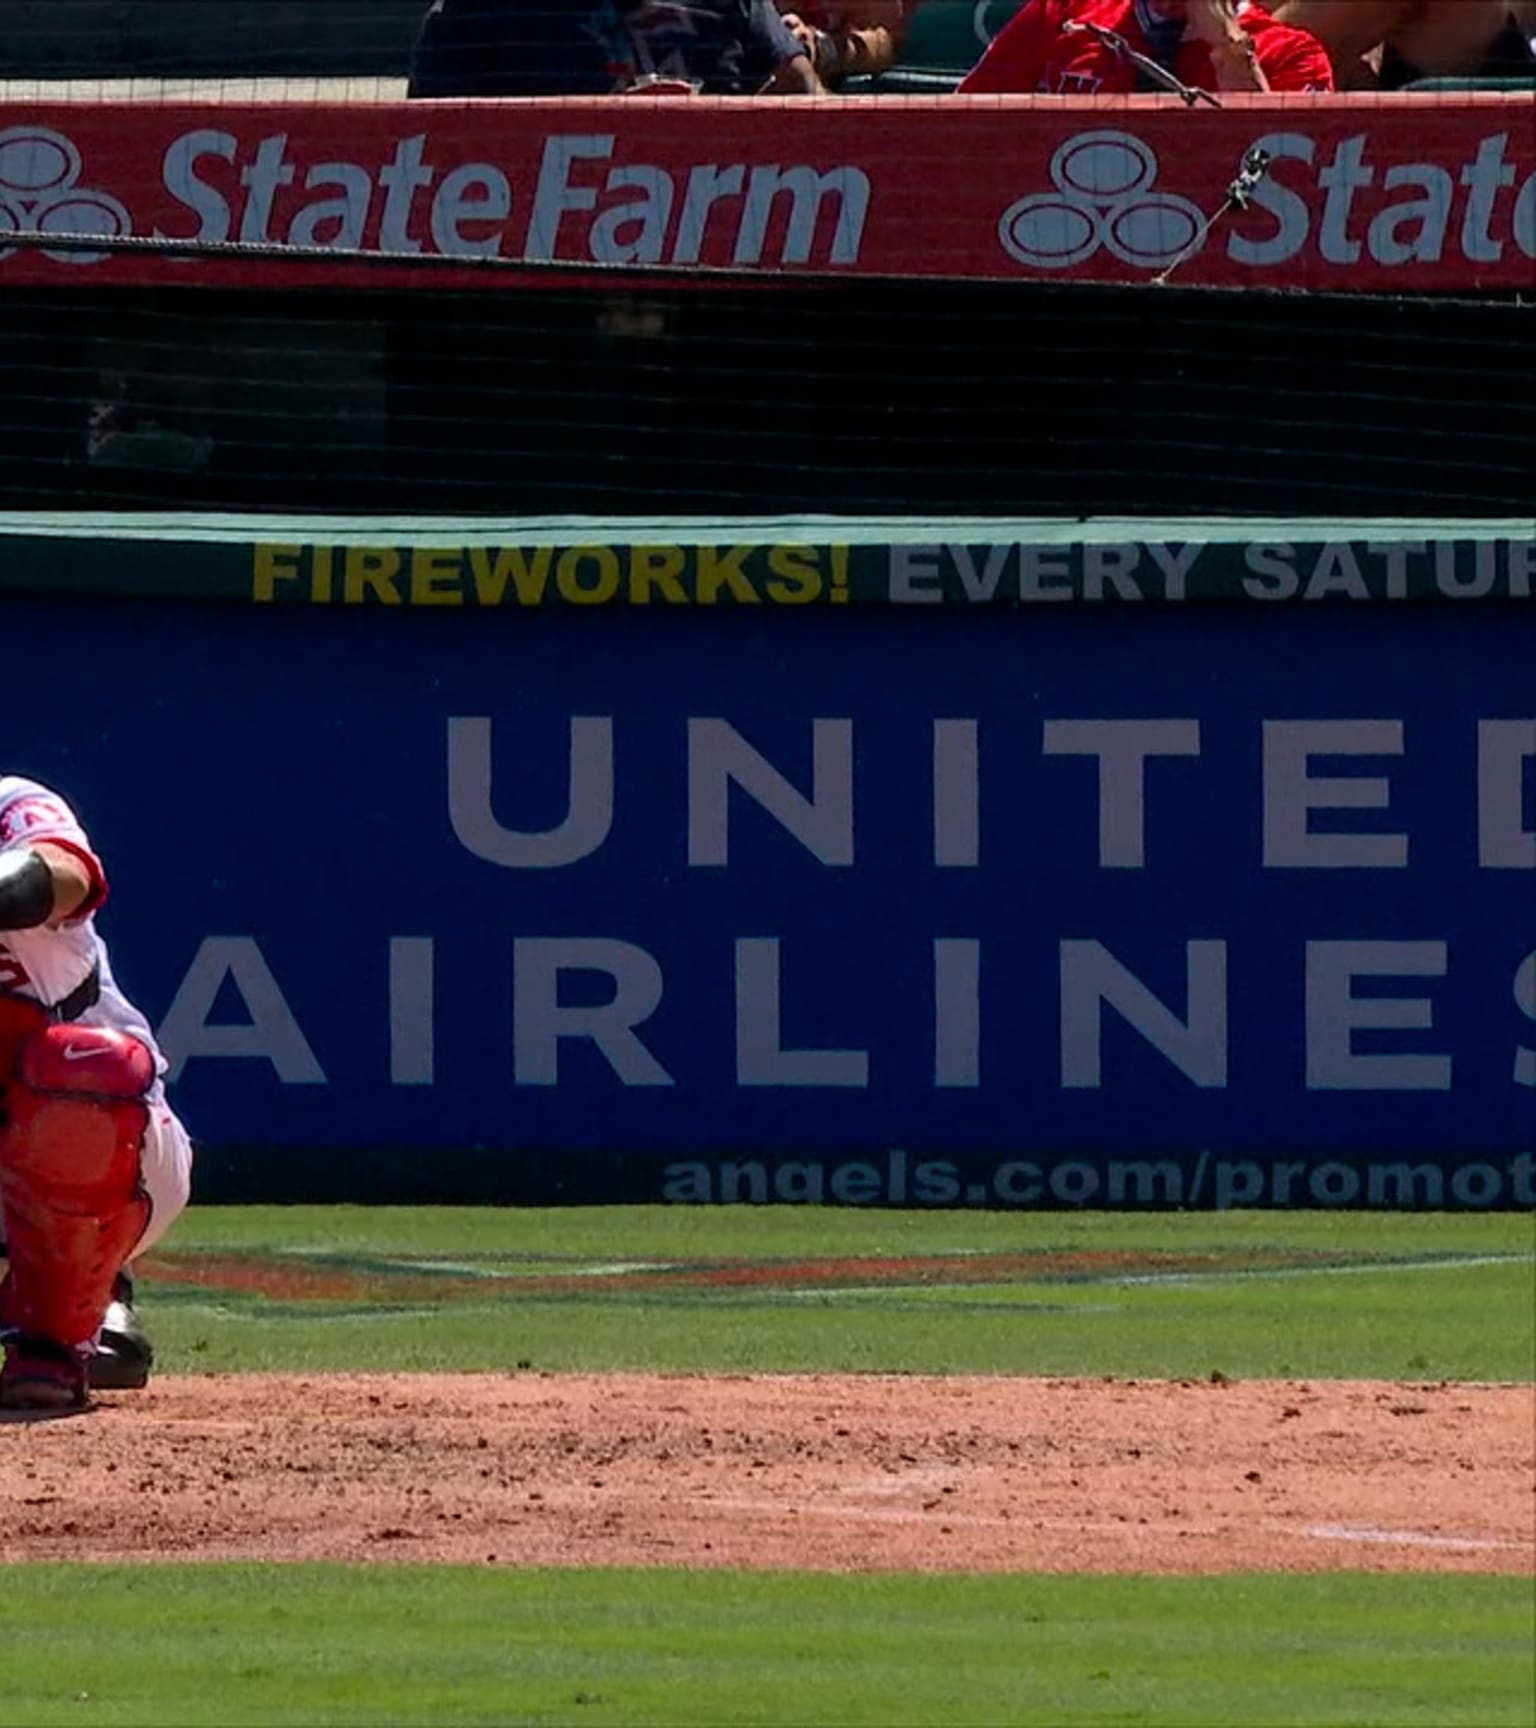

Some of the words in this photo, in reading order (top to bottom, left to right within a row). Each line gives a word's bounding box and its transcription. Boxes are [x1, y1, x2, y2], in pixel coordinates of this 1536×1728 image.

[154, 128, 871, 266] StateFarm
[253, 543, 849, 606] FIREWORKS!
[887, 541, 1204, 603] EVERY
[156, 934, 1536, 1093] AIRLINE
